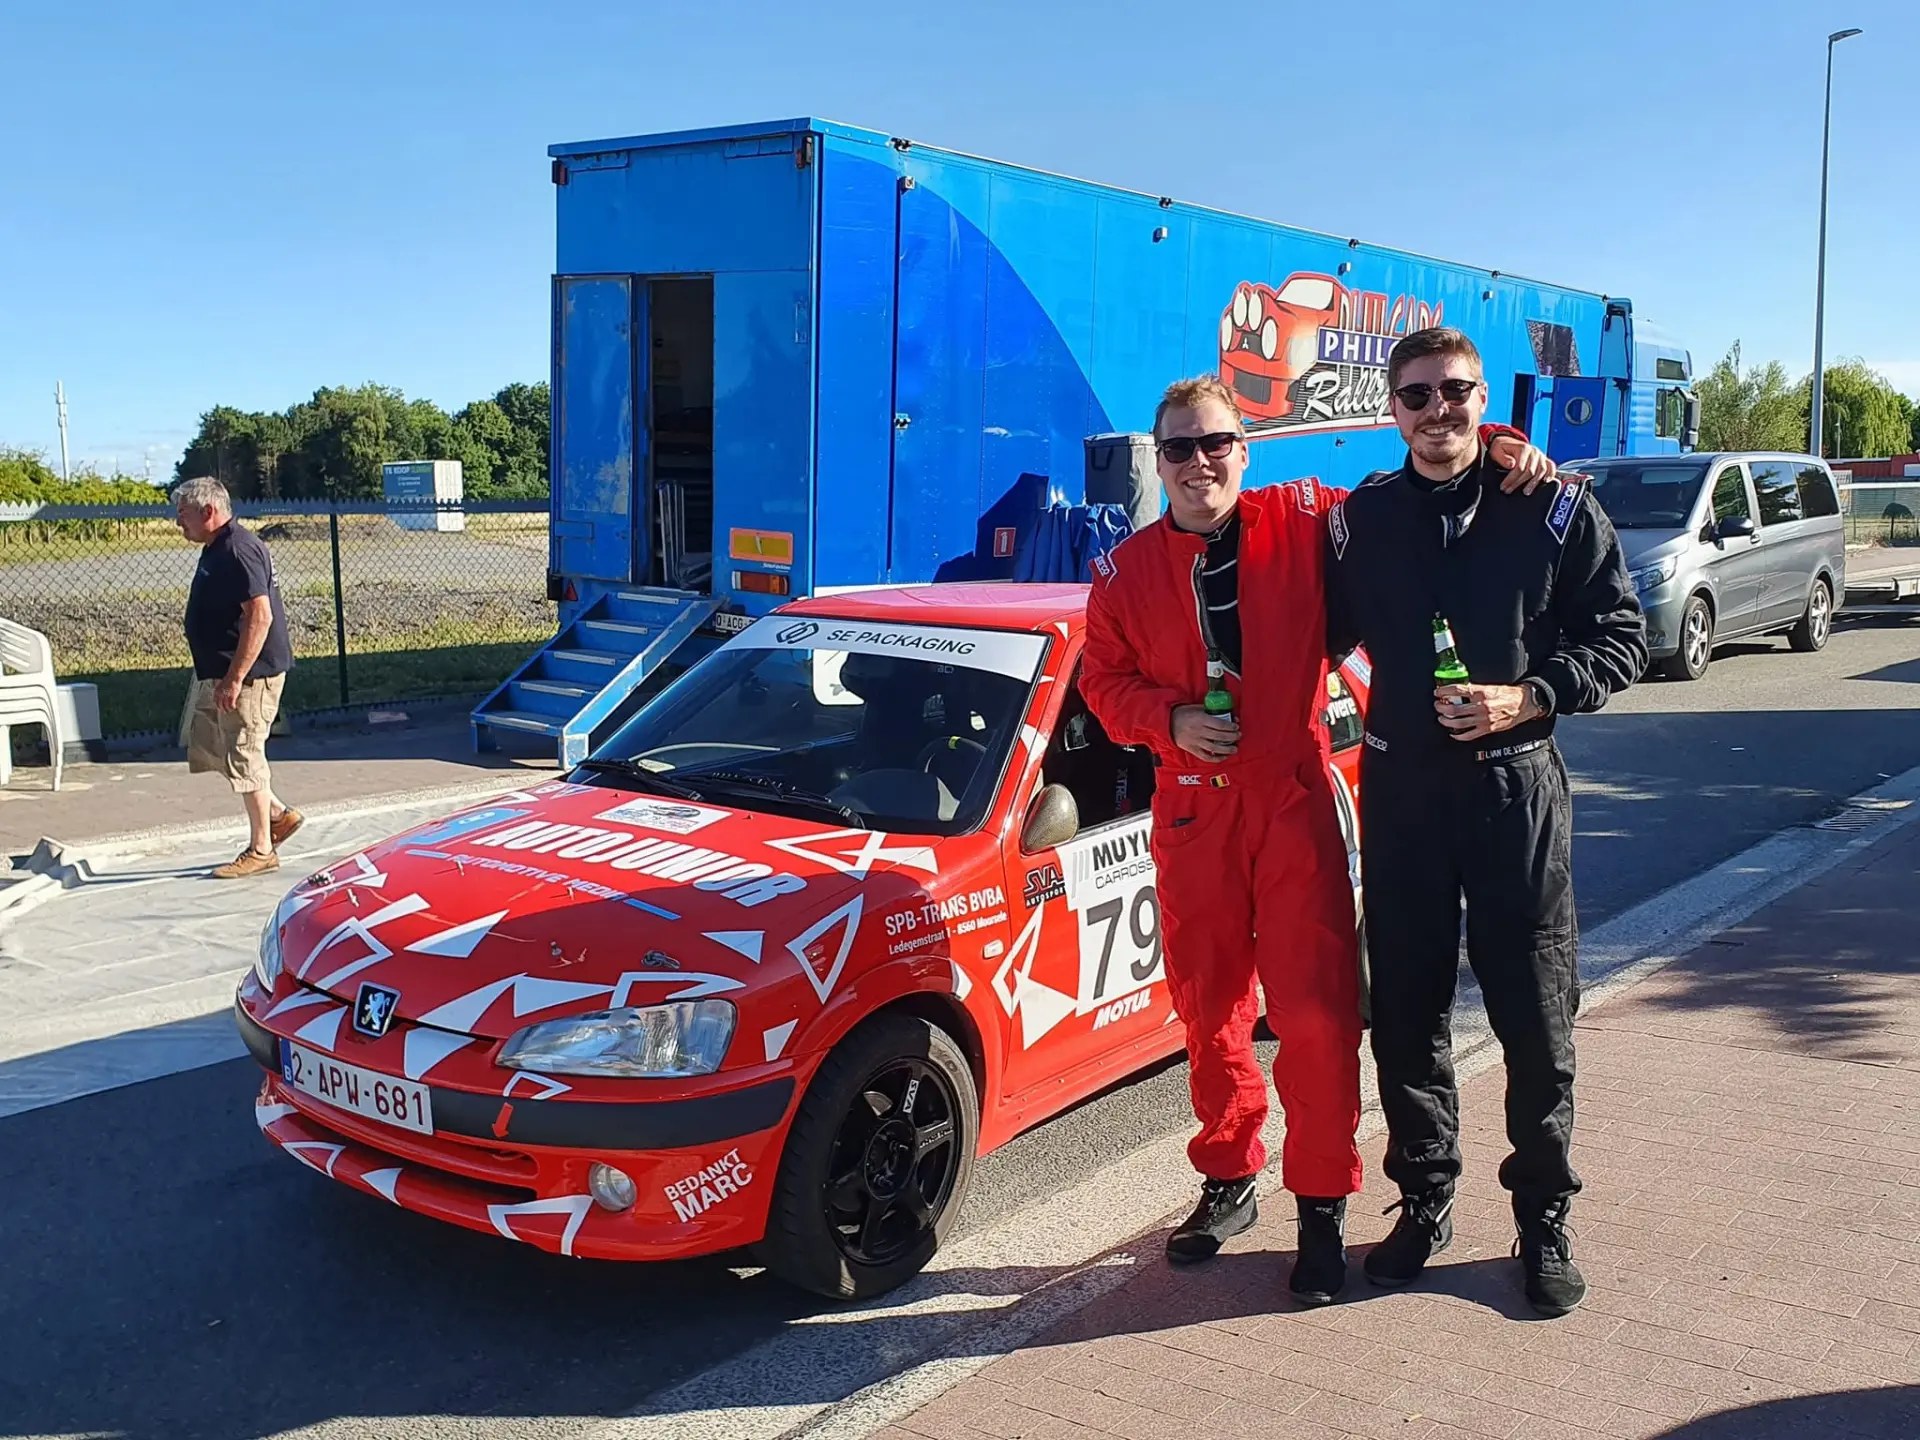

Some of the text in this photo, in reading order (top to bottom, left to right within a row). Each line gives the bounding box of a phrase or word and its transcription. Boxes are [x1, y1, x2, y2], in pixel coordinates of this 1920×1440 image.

[1552, 484, 1579, 527] sparco
[827, 630, 976, 655] SE PACKAGING
[446, 854, 570, 883] AUTOMOTIVE
[471, 820, 807, 907] AUTOJUNIOR
[885, 885, 1005, 936] SPB-TRANS BVBA
[1086, 884, 1163, 1000] 79
[1092, 987, 1152, 1031] MOTUL
[284, 1051, 424, 1126] B 2-APW-681
[663, 1148, 740, 1200] BEDANKT
[672, 1162, 753, 1223] MARC
